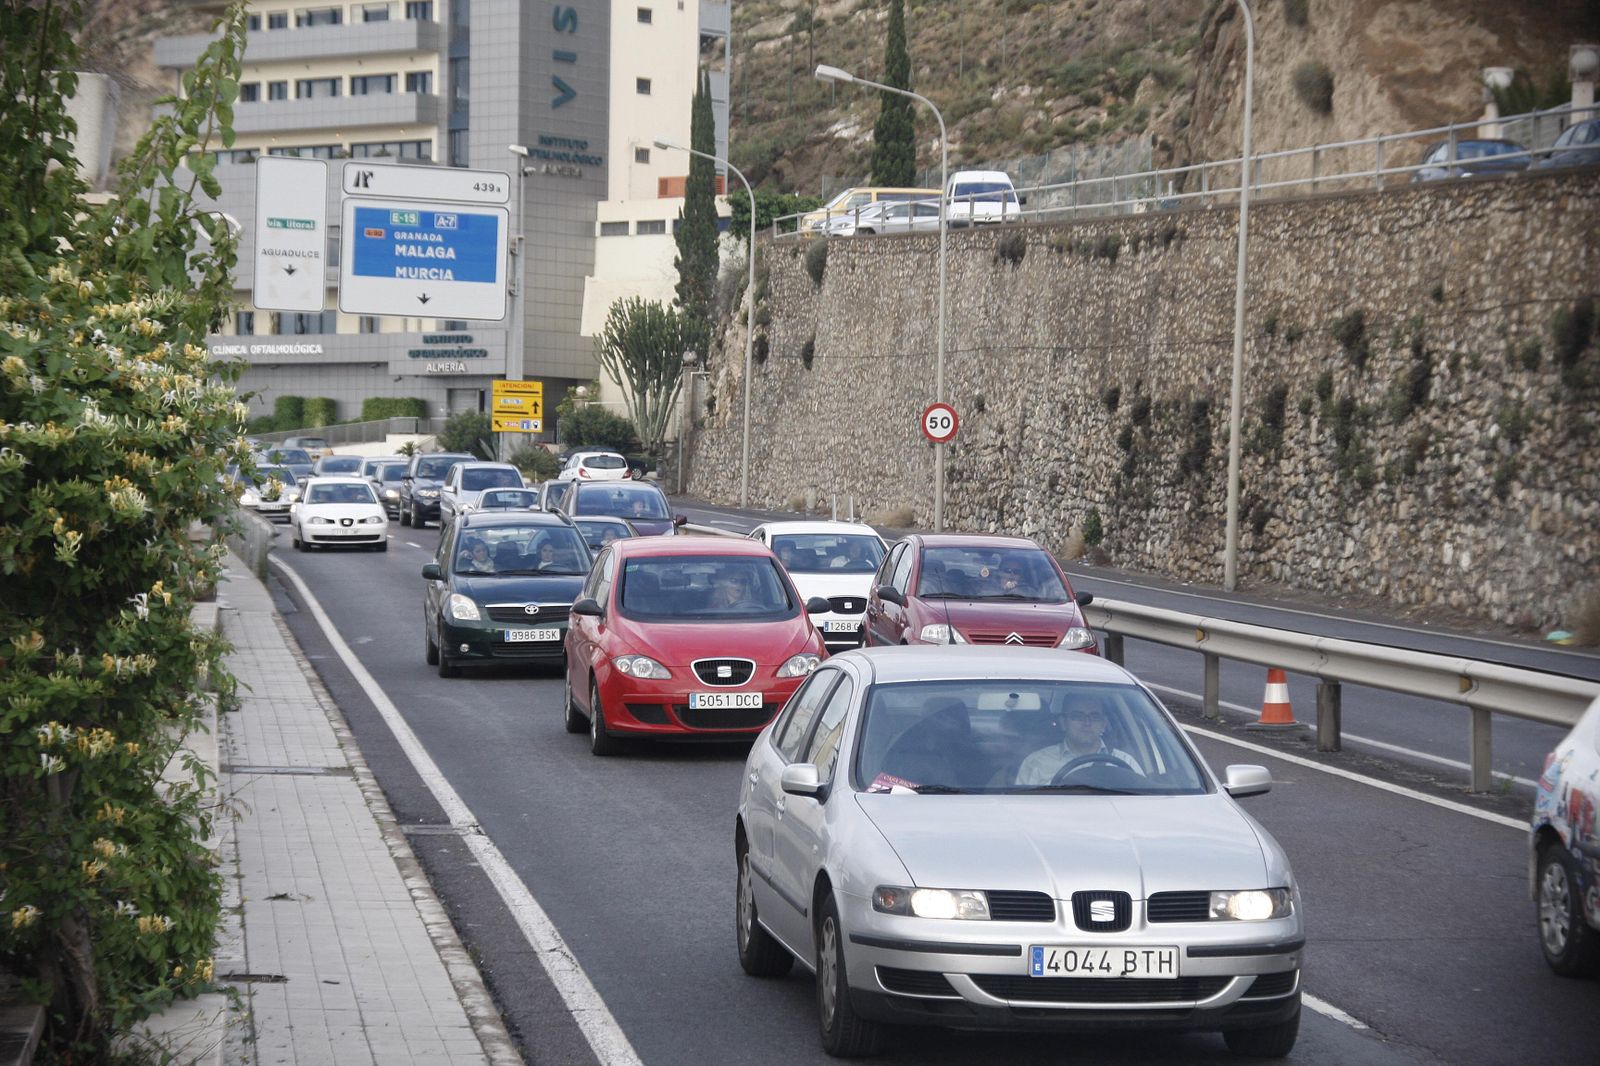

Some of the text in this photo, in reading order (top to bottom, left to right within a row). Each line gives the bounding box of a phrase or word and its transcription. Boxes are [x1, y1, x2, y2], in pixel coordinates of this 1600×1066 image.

[473, 182, 501, 192] 439a
[392, 213, 416, 223] E-15
[436, 216, 455, 227] A-7
[394, 231, 443, 242] GRANADA
[262, 249, 319, 259] AGUADULCE
[394, 244, 456, 259] MALAGA
[395, 266, 454, 280] MURCIA
[929, 416, 951, 430] 50
[830, 622, 852, 631] 1268
[511, 630, 557, 640] 9986 BSK
[699, 694, 760, 707] 5051 DCC
[1046, 949, 1112, 974] 4044
[1122, 949, 1173, 974] BTH
